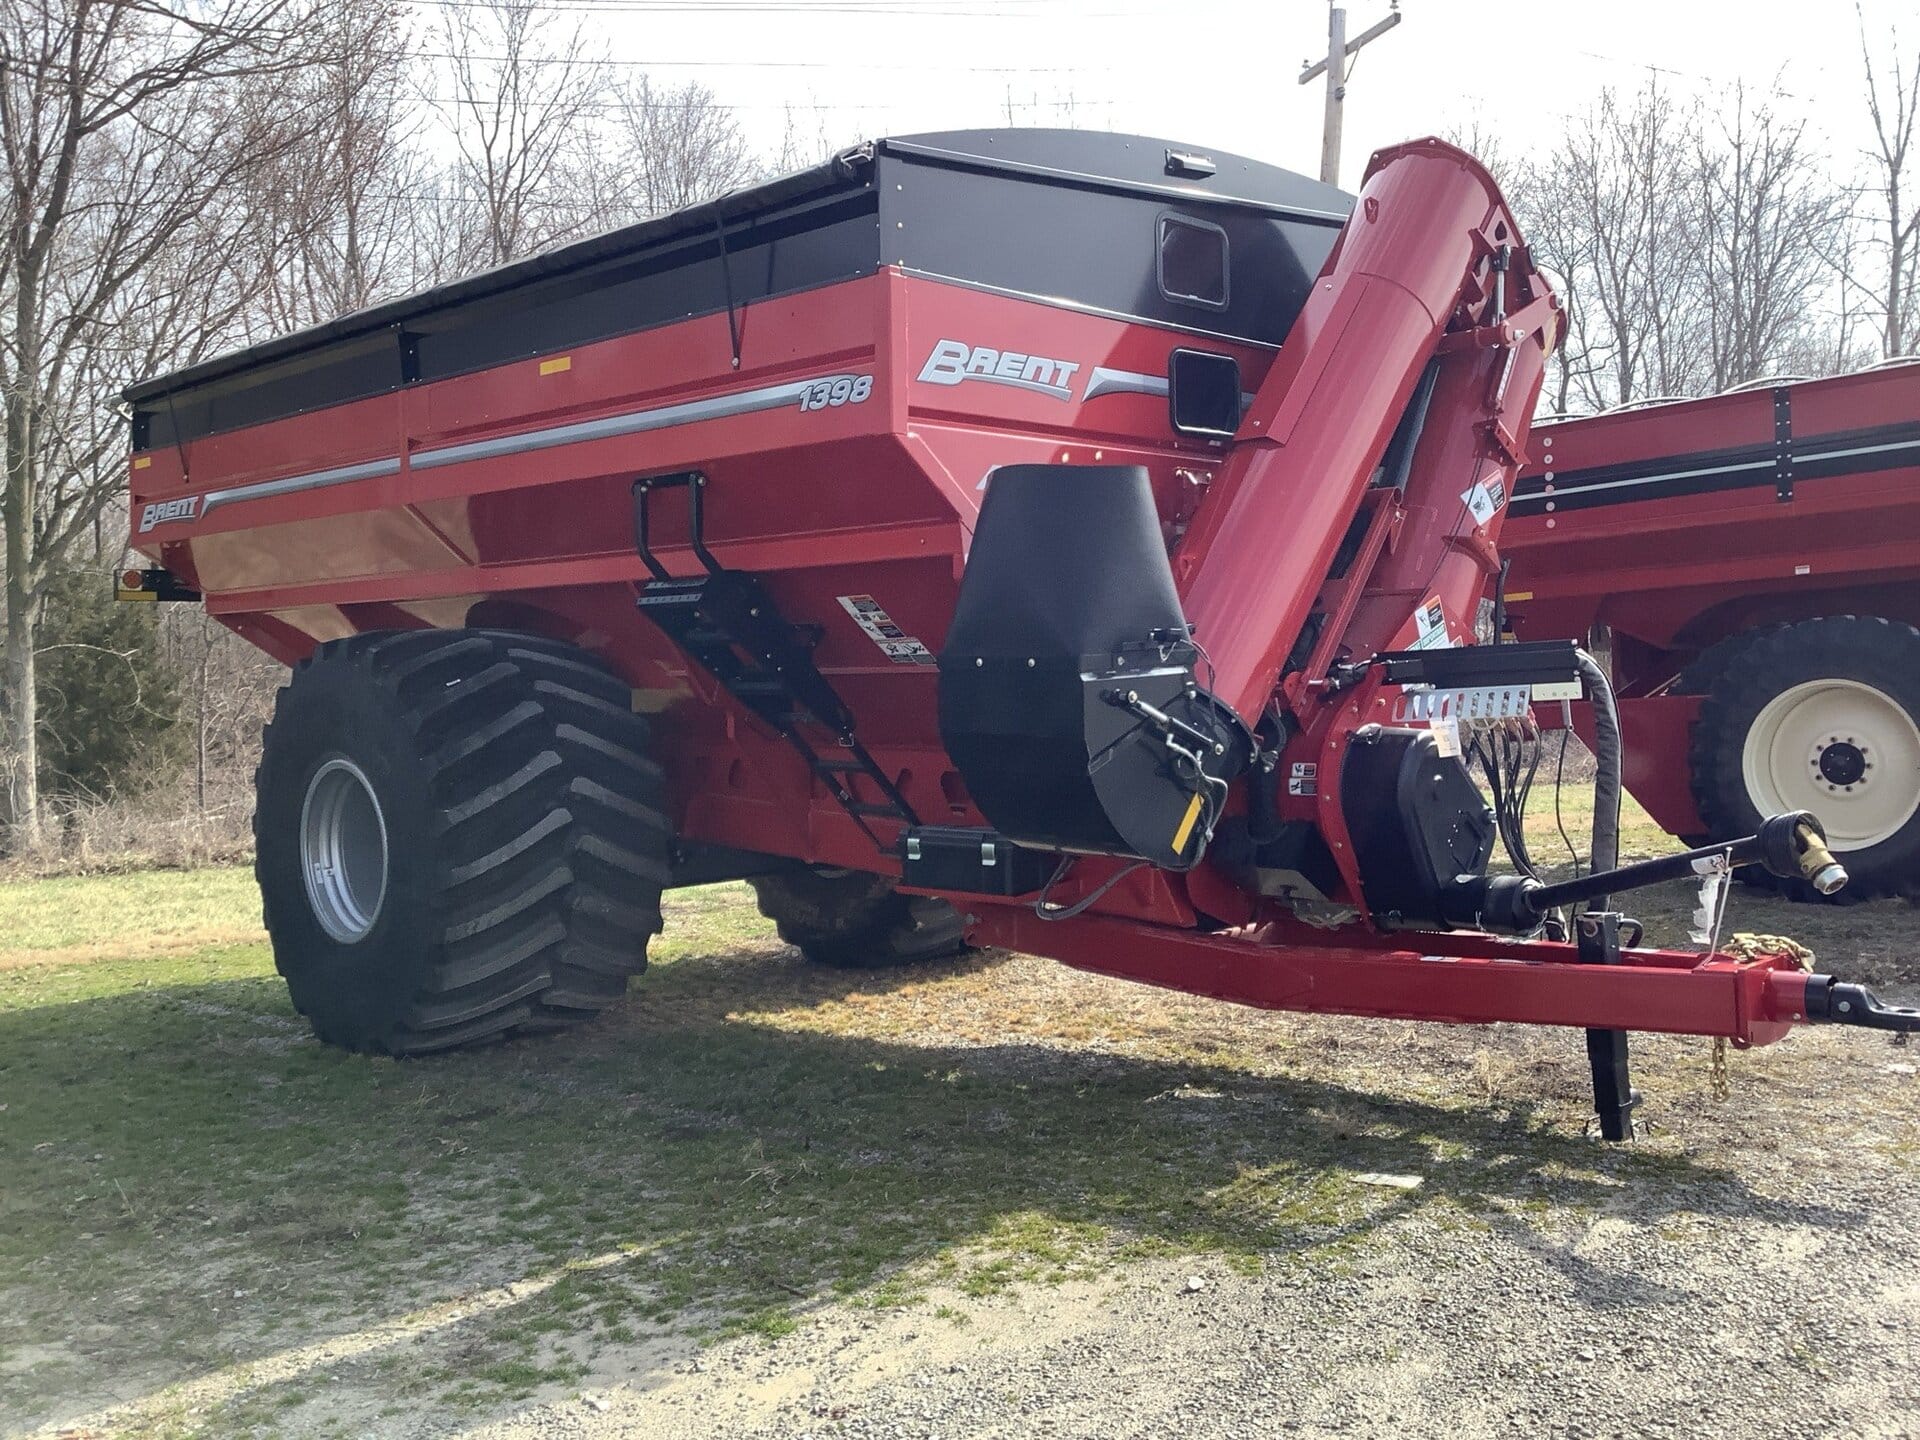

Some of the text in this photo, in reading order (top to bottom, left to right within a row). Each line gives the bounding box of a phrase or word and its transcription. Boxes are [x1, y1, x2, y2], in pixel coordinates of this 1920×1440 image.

[915, 338, 1080, 391] BRENT
[799, 374, 874, 412] 1398
[138, 496, 200, 533] BRENT
